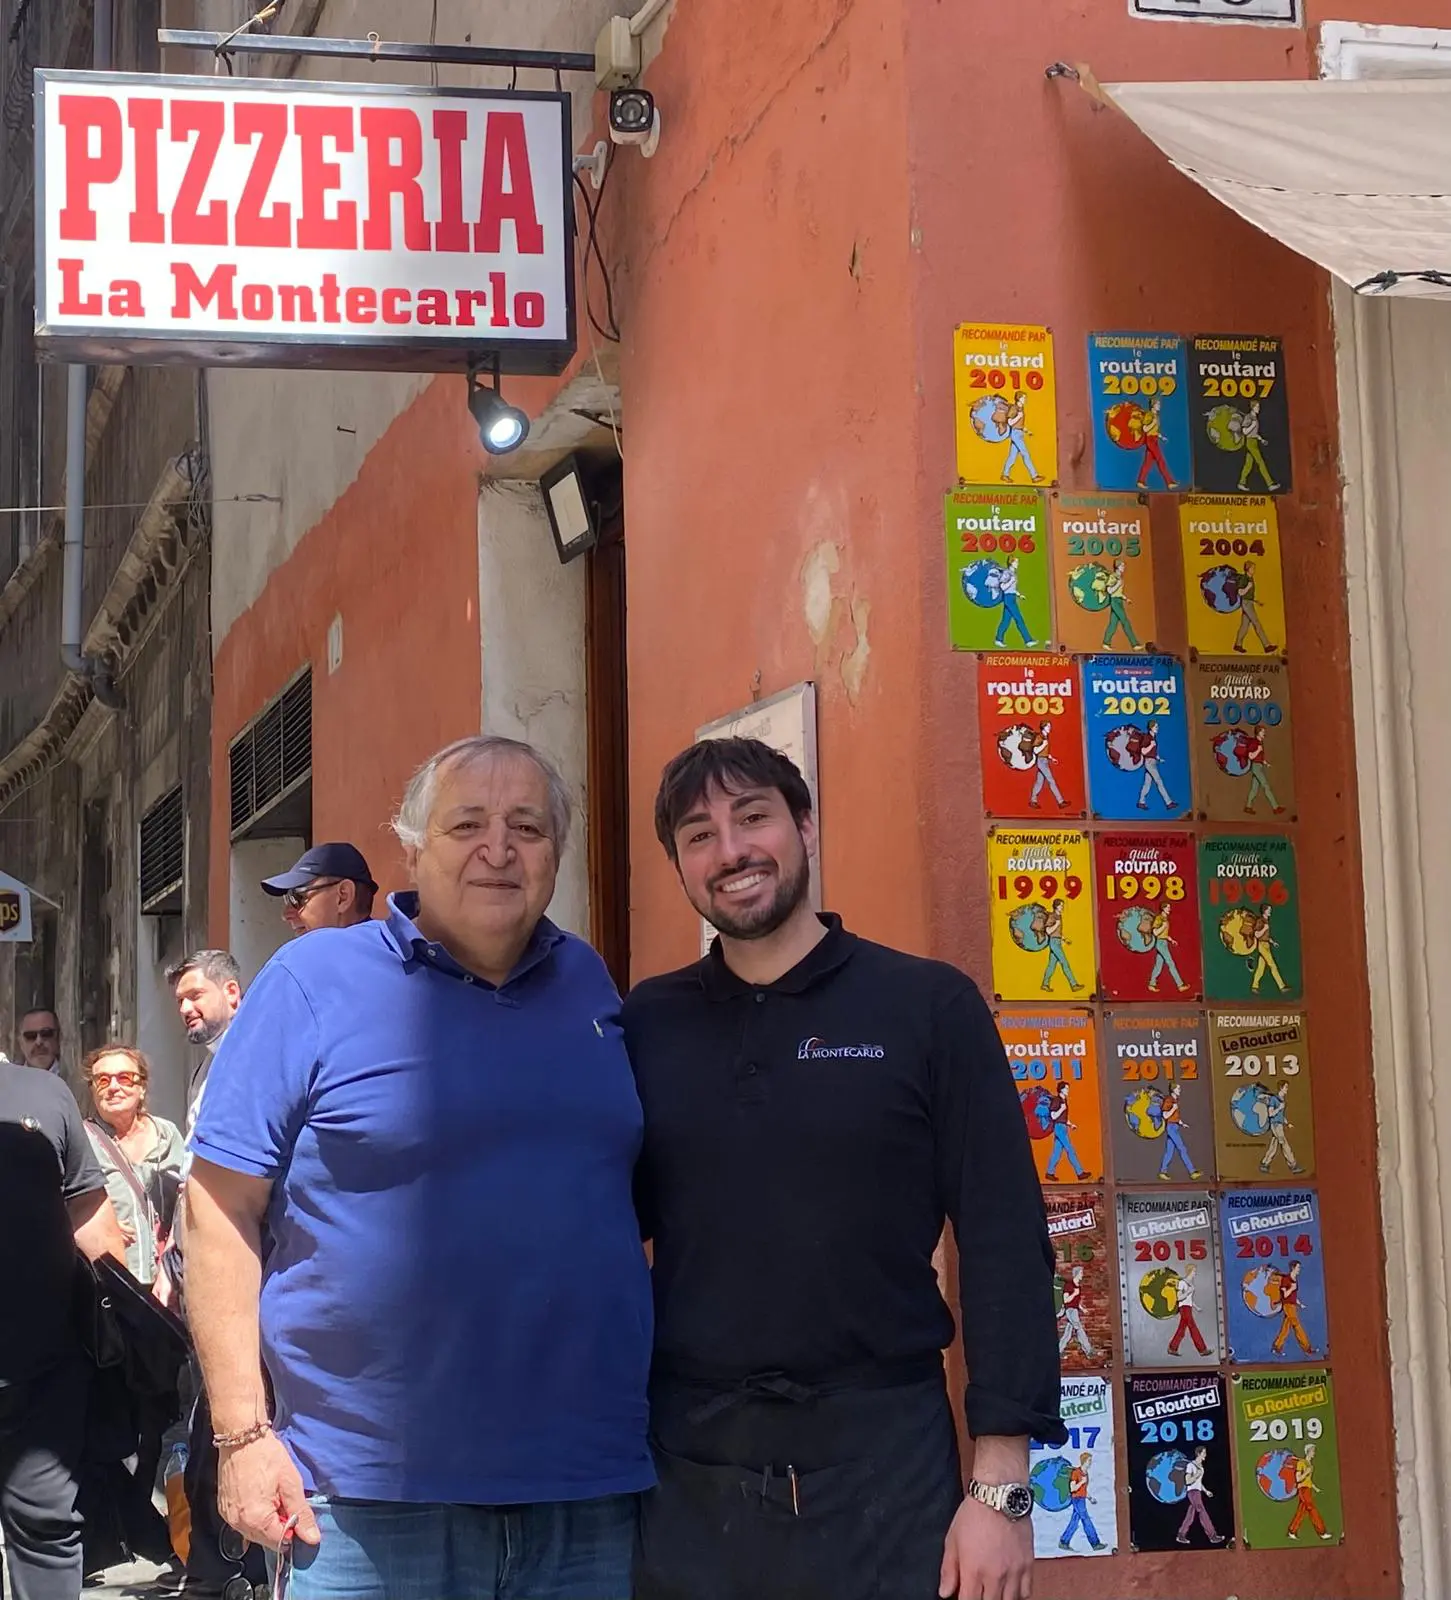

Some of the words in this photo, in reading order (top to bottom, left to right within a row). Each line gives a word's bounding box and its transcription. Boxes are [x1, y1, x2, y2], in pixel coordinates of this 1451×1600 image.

[58, 95, 544, 254] PIZZERIA
[58, 258, 145, 318] La
[170, 262, 545, 328] Montecarlo
[1028, 332, 1046, 342] PAR
[1161, 338, 1178, 348] PAR
[1133, 348, 1141, 357] le
[1260, 342, 1277, 352] PAR
[965, 352, 1043, 368] routard
[1100, 359, 1176, 375] routard
[1200, 361, 1275, 377] routard
[970, 369, 1043, 390] 2010
[1103, 375, 1176, 396] 2009
[1203, 378, 1274, 398] 2007
[1021, 495, 1037, 504] PAR
[1250, 497, 1266, 506] PAR
[992, 505, 1000, 514] le
[1097, 509, 1106, 517] le
[957, 515, 1035, 531] routard
[1063, 519, 1140, 535] routard
[1190, 519, 1267, 534] routard
[961, 533, 1035, 553] 2006
[1068, 536, 1141, 556] 2005
[1200, 538, 1265, 556] 2004
[1052, 657, 1069, 666] PAR
[1158, 657, 1172, 666] PAR
[1263, 665, 1280, 673] PAR
[1025, 667, 1034, 677] le
[987, 679, 1071, 696] routard
[1093, 676, 1176, 693] routard
[1211, 686, 1270, 699] ROUTARD
[998, 697, 1064, 715] 2003
[1104, 697, 1170, 715] 2002
[1204, 700, 1281, 725] 2000
[996, 834, 1061, 844] RECOMMANDÉ
[1063, 835, 1081, 844] PAR
[1170, 838, 1187, 847] PAR
[1270, 842, 1286, 851] PAR
[1129, 848, 1160, 861] guide
[1008, 859, 1071, 871] ROUTARD
[1115, 860, 1177, 874] ROUTARD
[1217, 865, 1277, 877] ROUTARD
[999, 876, 1082, 899] 1999
[1107, 875, 1184, 900] 1998
[1210, 878, 1288, 906] 1996
[0, 903, 18, 927] ps
[1282, 1016, 1300, 1026] PAR
[1040, 1029, 1049, 1038] le
[1152, 1029, 1160, 1038] le
[797, 1048, 809, 1060] LA
[811, 1047, 884, 1059] MONTECARLO
[1005, 1040, 1086, 1056] routard
[1117, 1039, 1197, 1057] routard
[1010, 1059, 1081, 1080] 2011
[1123, 1059, 1198, 1081] 2012
[1225, 1055, 1300, 1076] 2013
[1191, 1201, 1208, 1210] PAR
[1294, 1194, 1311, 1203] PAR
[1057, 1241, 1095, 1262] 16
[1135, 1240, 1207, 1261] 2015
[1236, 1235, 1312, 1258] 2014
[1200, 1378, 1218, 1387] PAR
[1309, 1376, 1326, 1386] PAR
[1088, 1385, 1106, 1395] PAR
[1140, 1419, 1214, 1443] 2018
[1250, 1418, 1322, 1441] 2019
